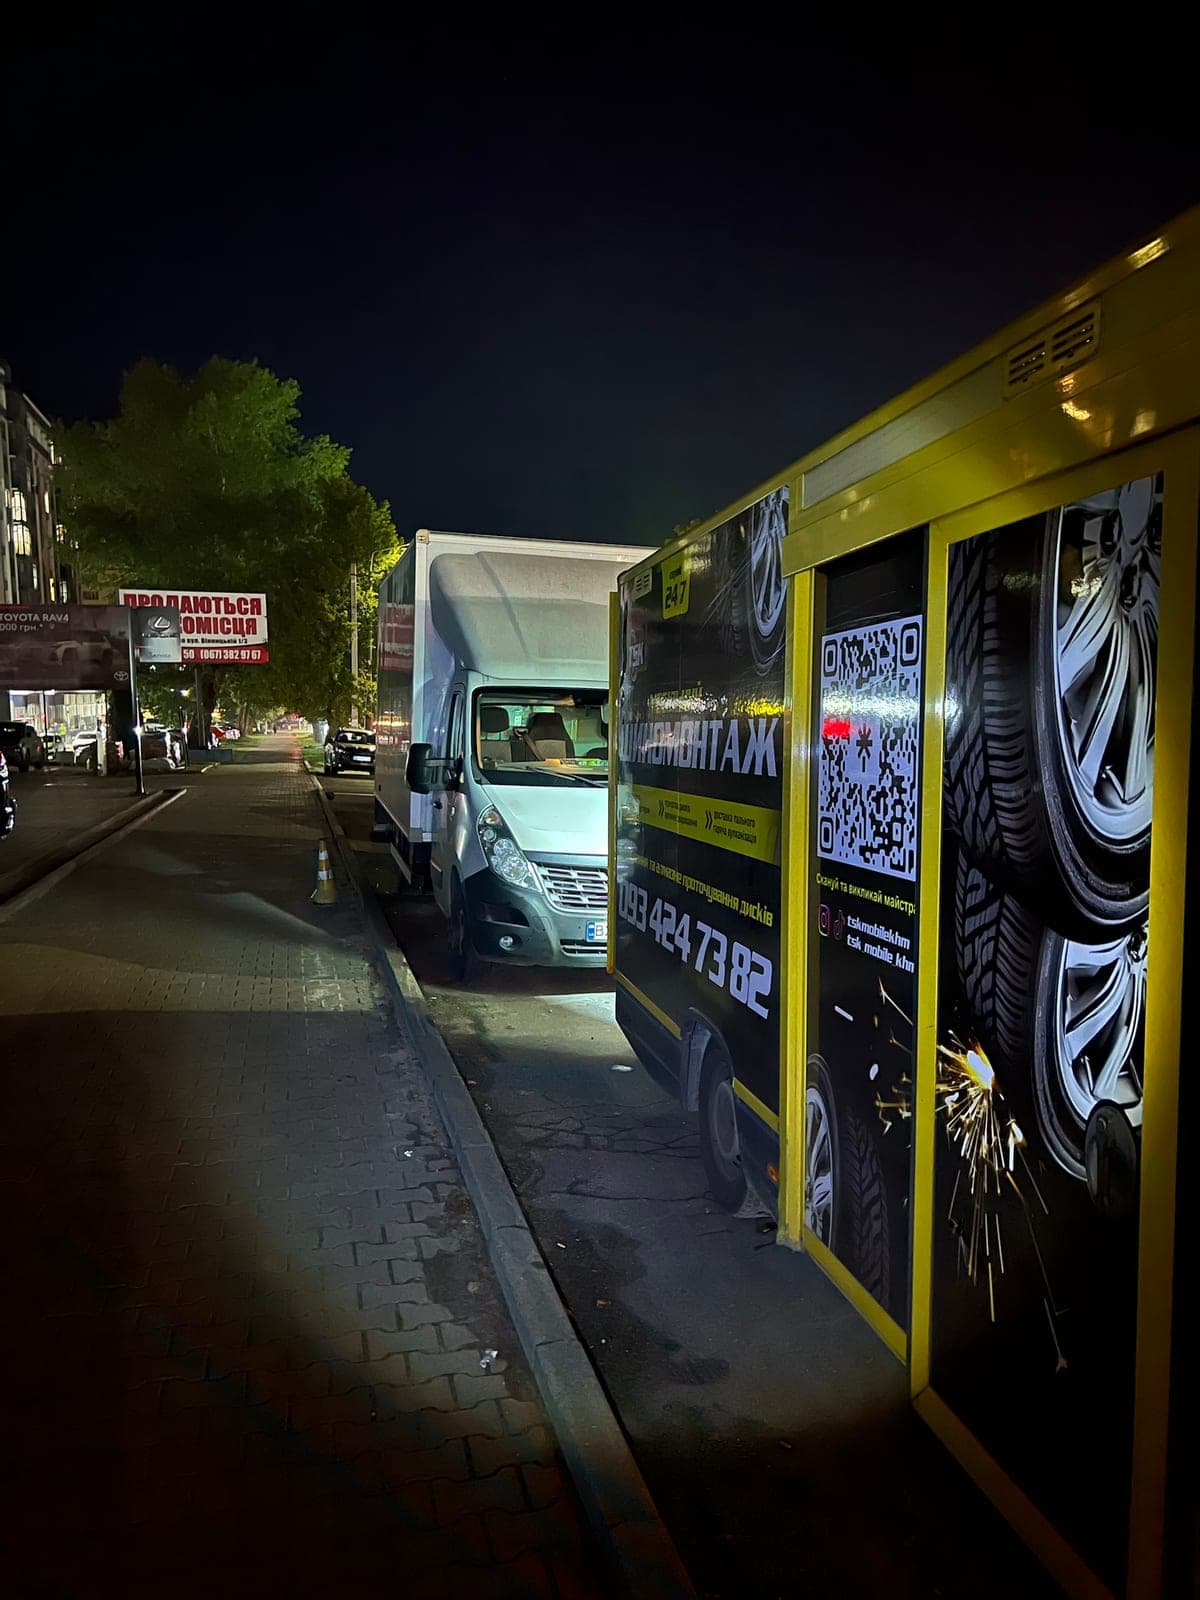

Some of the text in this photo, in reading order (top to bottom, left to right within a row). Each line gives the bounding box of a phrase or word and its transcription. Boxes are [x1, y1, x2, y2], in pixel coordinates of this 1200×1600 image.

[0, 613, 69, 623] TOYOTA RAV4
[180, 616, 257, 637] ОМІСЦЯ
[816, 873, 839, 891] Скануй
[840, 881, 848, 892] та
[849, 883, 882, 904] викликай
[619, 880, 773, 1020] 093 424 73 82
